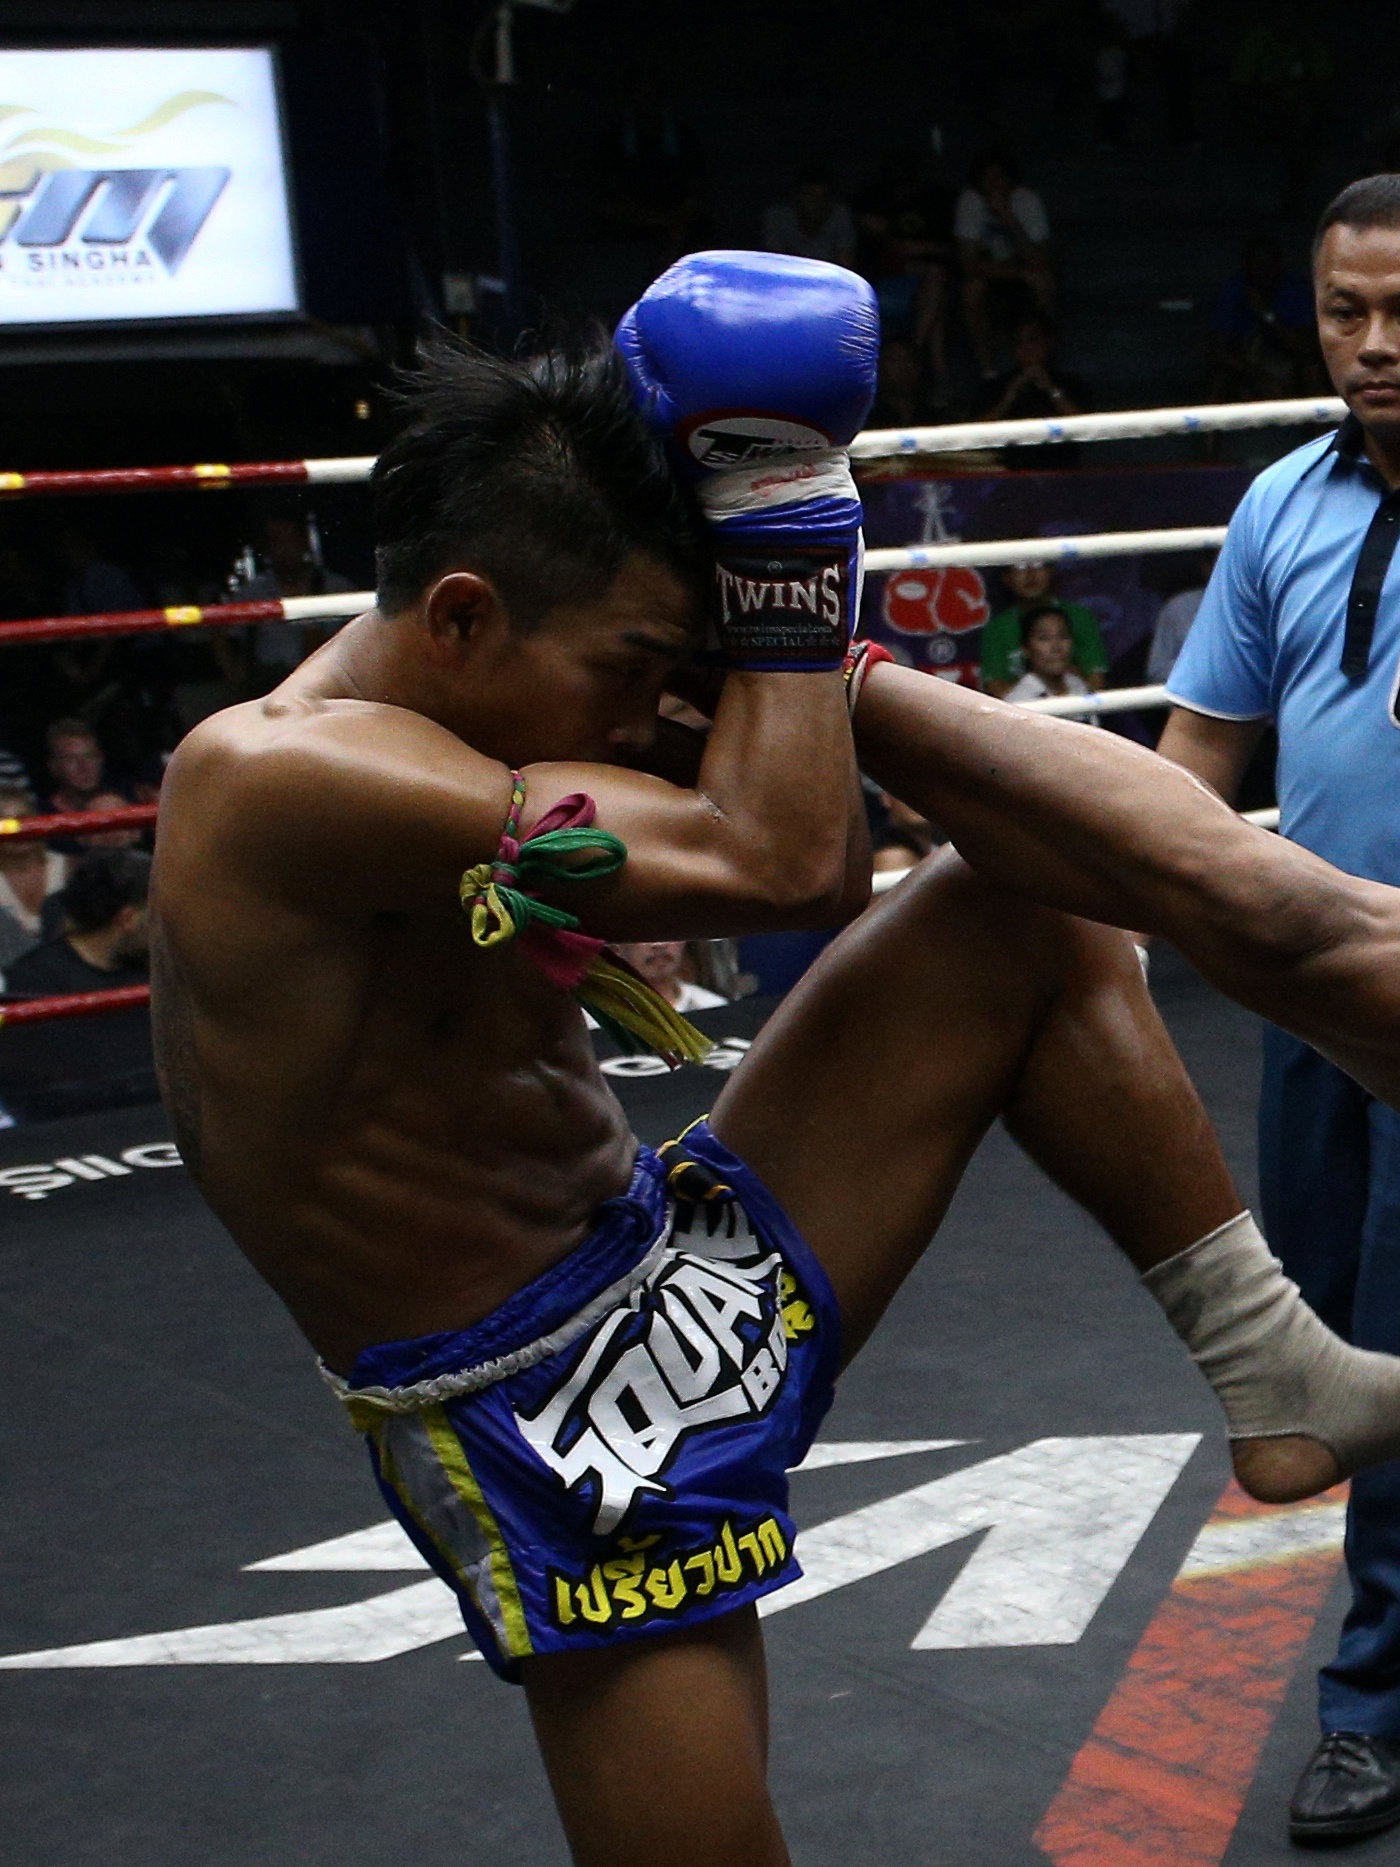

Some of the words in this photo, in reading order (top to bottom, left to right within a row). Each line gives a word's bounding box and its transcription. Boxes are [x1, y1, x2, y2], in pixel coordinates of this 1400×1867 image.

[28, 250, 152, 272] SINGHA
[715, 562, 841, 627] TWINS
[554, 1517, 787, 1625] เปรี้ยวปาก
